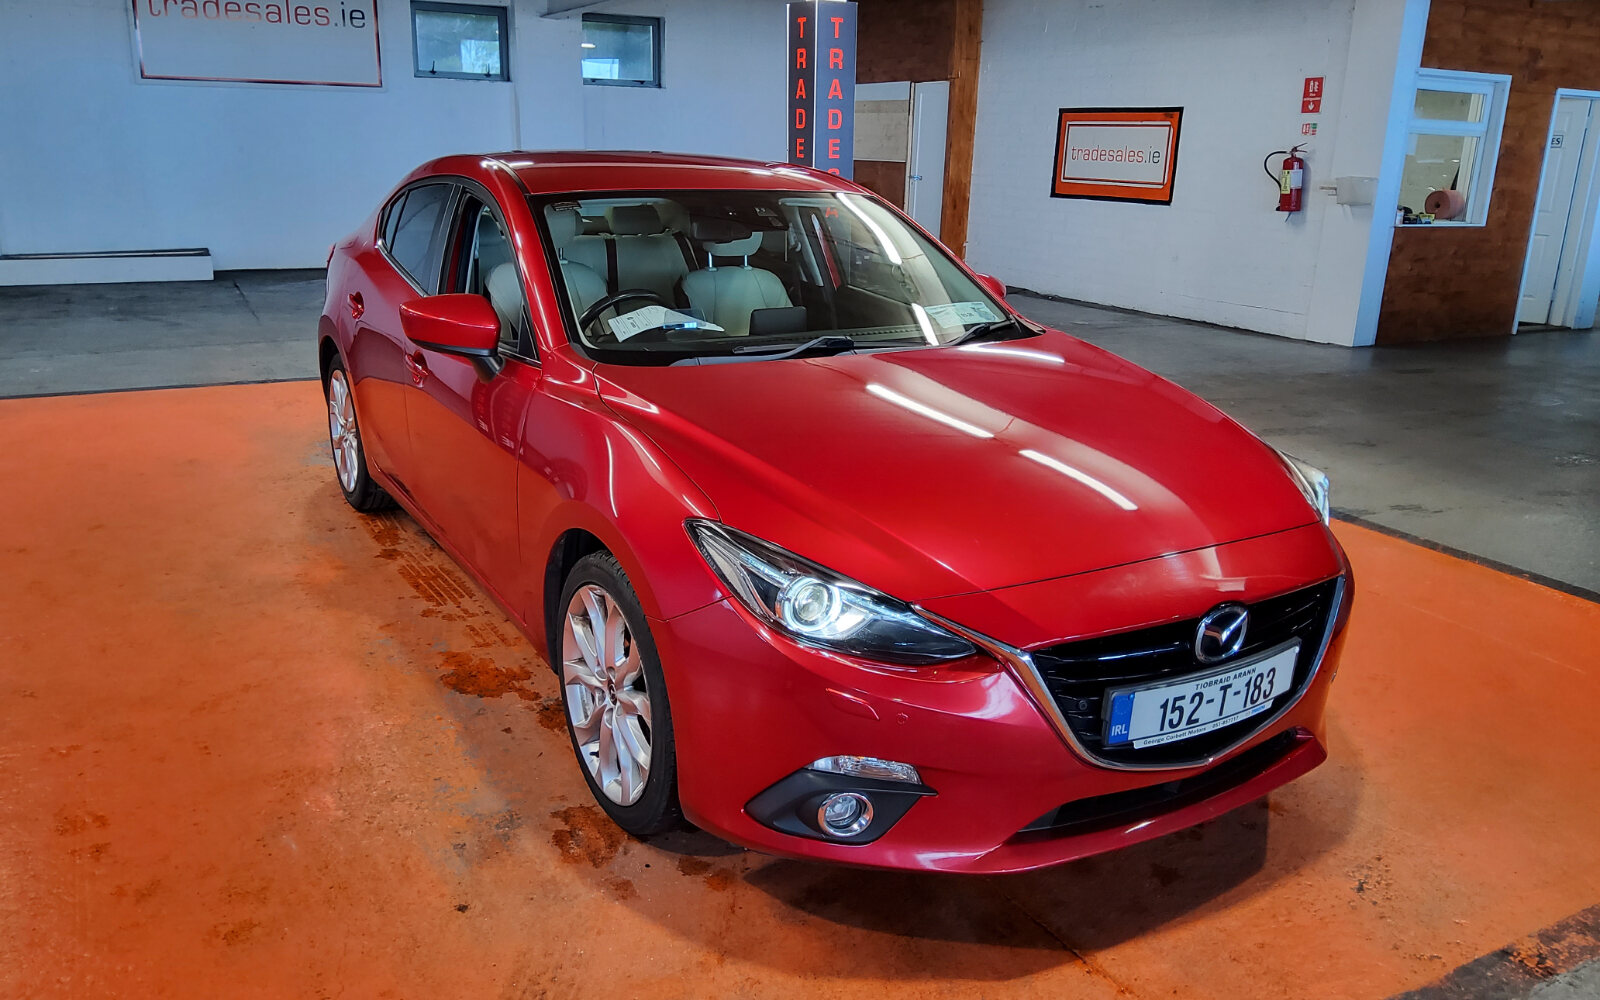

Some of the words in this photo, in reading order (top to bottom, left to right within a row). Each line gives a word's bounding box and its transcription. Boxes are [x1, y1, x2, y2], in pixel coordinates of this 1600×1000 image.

[149, 0, 366, 29] tradesales.ie
[1070, 144, 1161, 164] tradesales.ie
[1195, 675, 1231, 690] TIOBRAID
[1232, 667, 1257, 680] ARANN
[1159, 666, 1277, 732] 152-T-183
[1111, 722, 1128, 736] IRL
[1143, 737, 1165, 746] George
